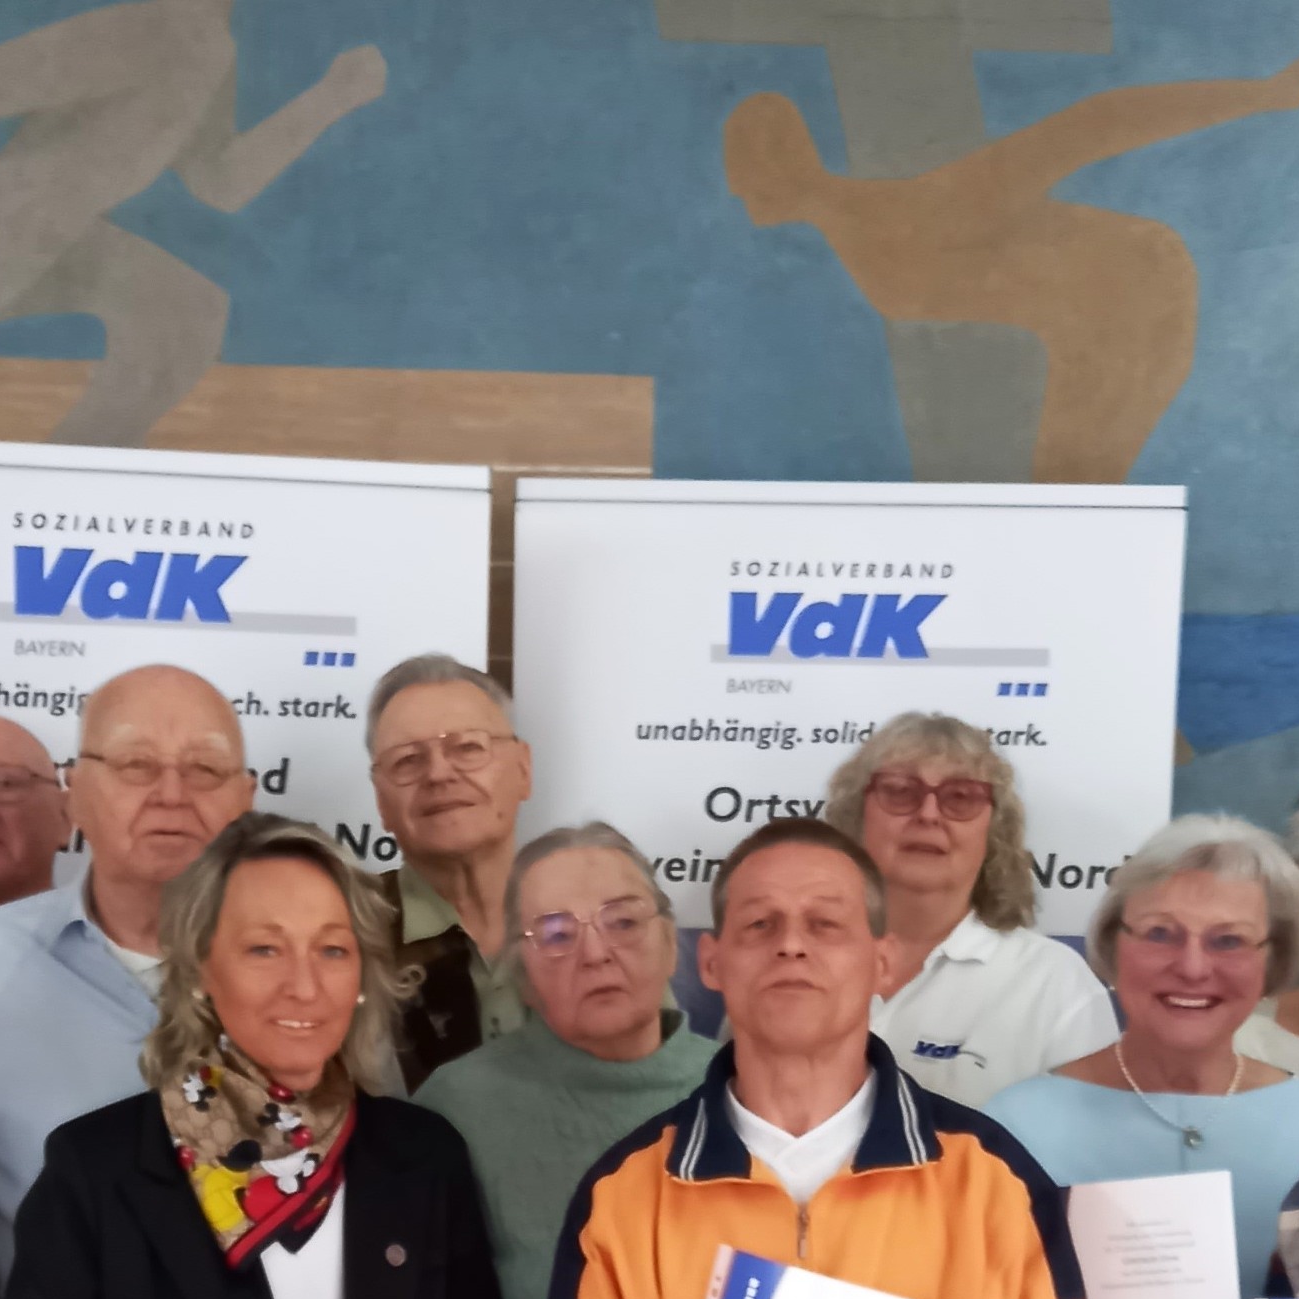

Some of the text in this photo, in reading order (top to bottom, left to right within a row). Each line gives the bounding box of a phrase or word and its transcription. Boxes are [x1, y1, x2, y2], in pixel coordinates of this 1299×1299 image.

[12, 512, 256, 539] SOZIALVERBAND
[730, 560, 956, 579] SOZIALVERBAND
[13, 546, 249, 623] VdK
[728, 592, 948, 659] VdK
[14, 640, 86, 658] BAYERN
[726, 679, 792, 695] BAYERN
[278, 692, 357, 720] stark.
[636, 718, 802, 750] unabhängig.
[334, 823, 398, 861] No
